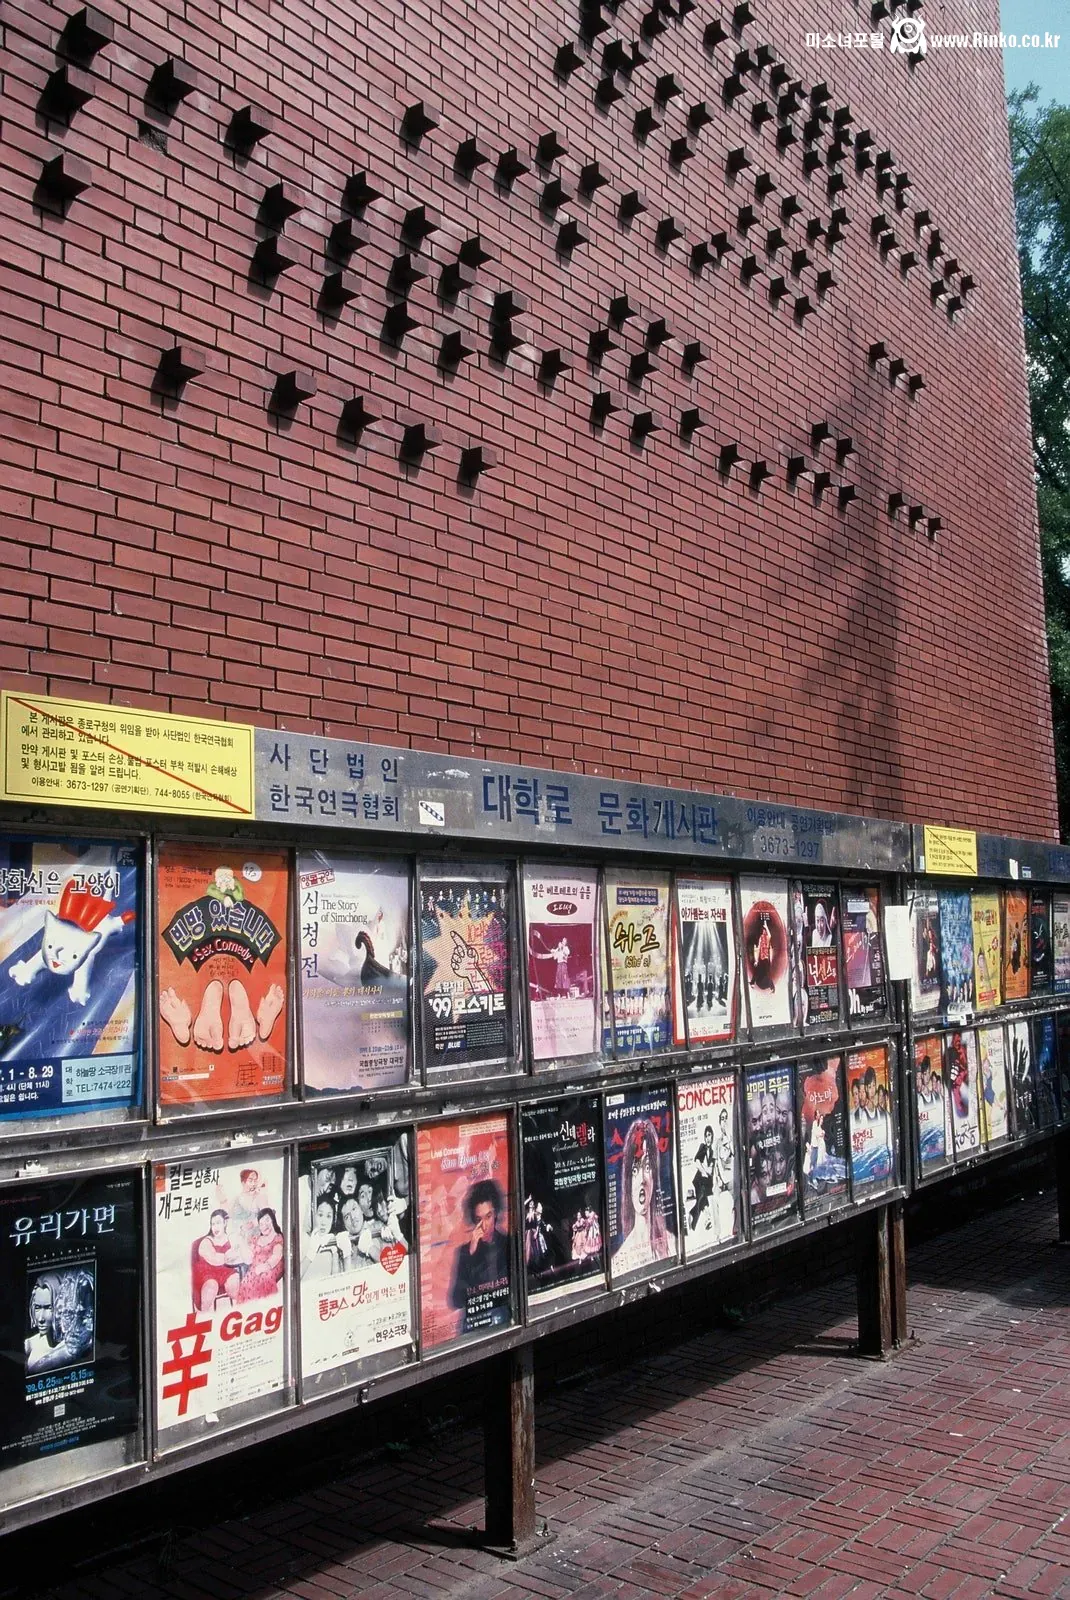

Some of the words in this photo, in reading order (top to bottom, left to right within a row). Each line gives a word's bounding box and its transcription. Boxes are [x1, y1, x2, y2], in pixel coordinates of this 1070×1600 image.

[21, 725, 38, 738] 에서
[42, 727, 74, 741] 관리하고
[29, 712, 38, 724] 본
[78, 718, 116, 733] 종로구청의
[120, 723, 141, 736] 위임을
[145, 727, 159, 739] 받아
[163, 729, 190, 742] 사단법인
[194, 733, 234, 748] 한국연극협회
[21, 743, 38, 756] 만약
[42, 746, 66, 759] 게시판
[70, 749, 78, 760] 및
[82, 751, 105, 763] 포스터
[145, 757, 167, 769] 포스터
[170, 760, 184, 771] 부착
[187, 762, 208, 774] 적발시
[211, 764, 237, 777] 손해배상
[21, 757, 29, 769] 및
[33, 759, 66, 773] 형사고발
[70, 763, 86, 775] 됨을
[90, 765, 105, 777] 알려
[109, 767, 141, 780] 드립니다.
[32, 777, 62, 787] 이용안내:
[66, 780, 109, 792] 3673-1297
[155, 788, 190, 799] 744-8055
[270, 784, 399, 821] 한국연극협회
[483, 775, 573, 825] 대학로
[598, 792, 718, 845] 문화게시판
[760, 835, 820, 859] 3673-1297
[70, 869, 120, 898] 고양이
[320, 899, 337, 910] The
[338, 899, 359, 912] Story
[320, 912, 330, 923] of
[331, 912, 368, 924] Simchong
[168, 906, 206, 952] 빈방
[208, 898, 275, 955] 있습니다
[301, 890, 319, 979] 심청전
[194, 943, 215, 961] Sex
[215, 939, 253, 961] Comedy
[428, 997, 453, 1018] '99
[454, 993, 506, 1016] 모스키토
[9, 1068, 14, 1080] 1
[28, 1066, 38, 1080] 8.
[42, 1065, 54, 1078] 29
[75, 1068, 97, 1078] 하늘땅
[6, 1083, 16, 1091] 4시
[676, 1082, 736, 1112] CONCERT
[560, 1120, 596, 1148] 신데렐라
[158, 1193, 209, 1220] 개그콘서트
[9, 1204, 116, 1247] 유리가면
[219, 1305, 284, 1342] Gag
[375, 1323, 408, 1343] 연우소극장
[161, 1312, 213, 1417] 辛
